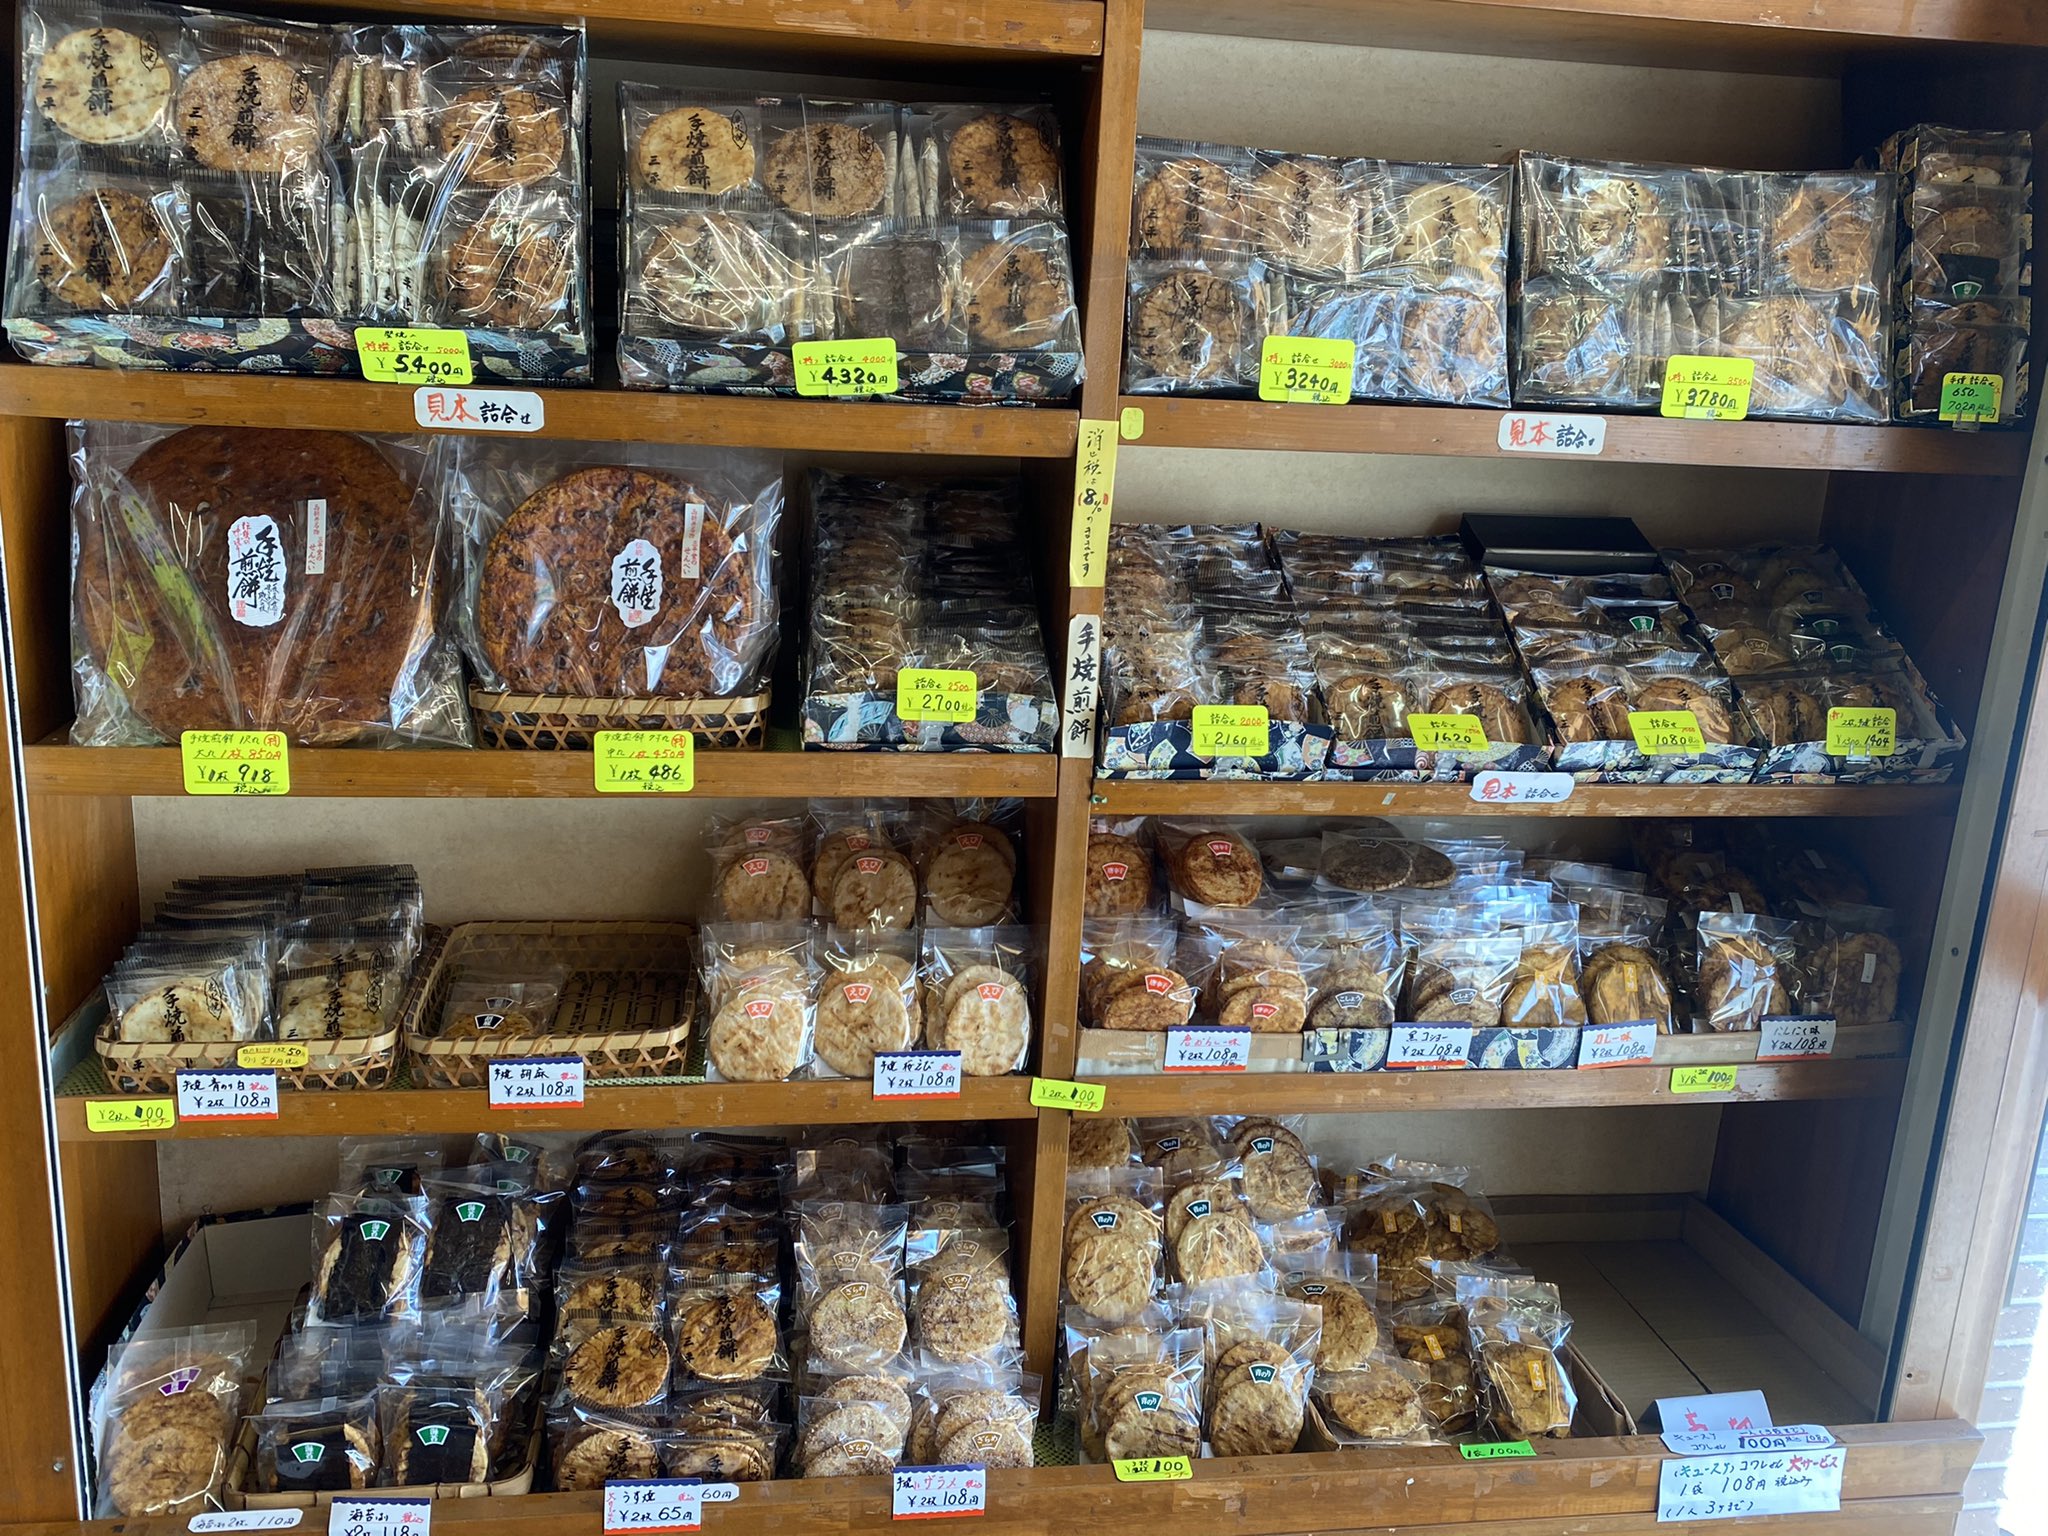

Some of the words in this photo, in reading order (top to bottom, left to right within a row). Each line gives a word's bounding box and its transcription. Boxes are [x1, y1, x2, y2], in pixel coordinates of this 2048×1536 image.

[684, 113, 711, 190] 手焼煎餅
[427, 392, 479, 422] 見本
[479, 400, 532, 425] 詰合せ
[1510, 418, 1554, 446] 見本
[1065, 622, 1097, 745] 手焼煎餅
[238, 764, 273, 783] 918
[649, 764, 681, 780] 486
[1482, 778, 1519, 799] 見本
[1775, 1026, 1820, 1035] にんにく味
[520, 1067, 549, 1080] 胡麻
[1739, 1437, 1786, 1449] 100円
[1786, 1454, 1838, 1473] 大サービス
[1722, 1476, 1766, 1493] 108円
[1775, 1475, 1812, 1487] 税込み
[624, 1492, 655, 1503] うす焼
[702, 1489, 731, 1499] 60円
